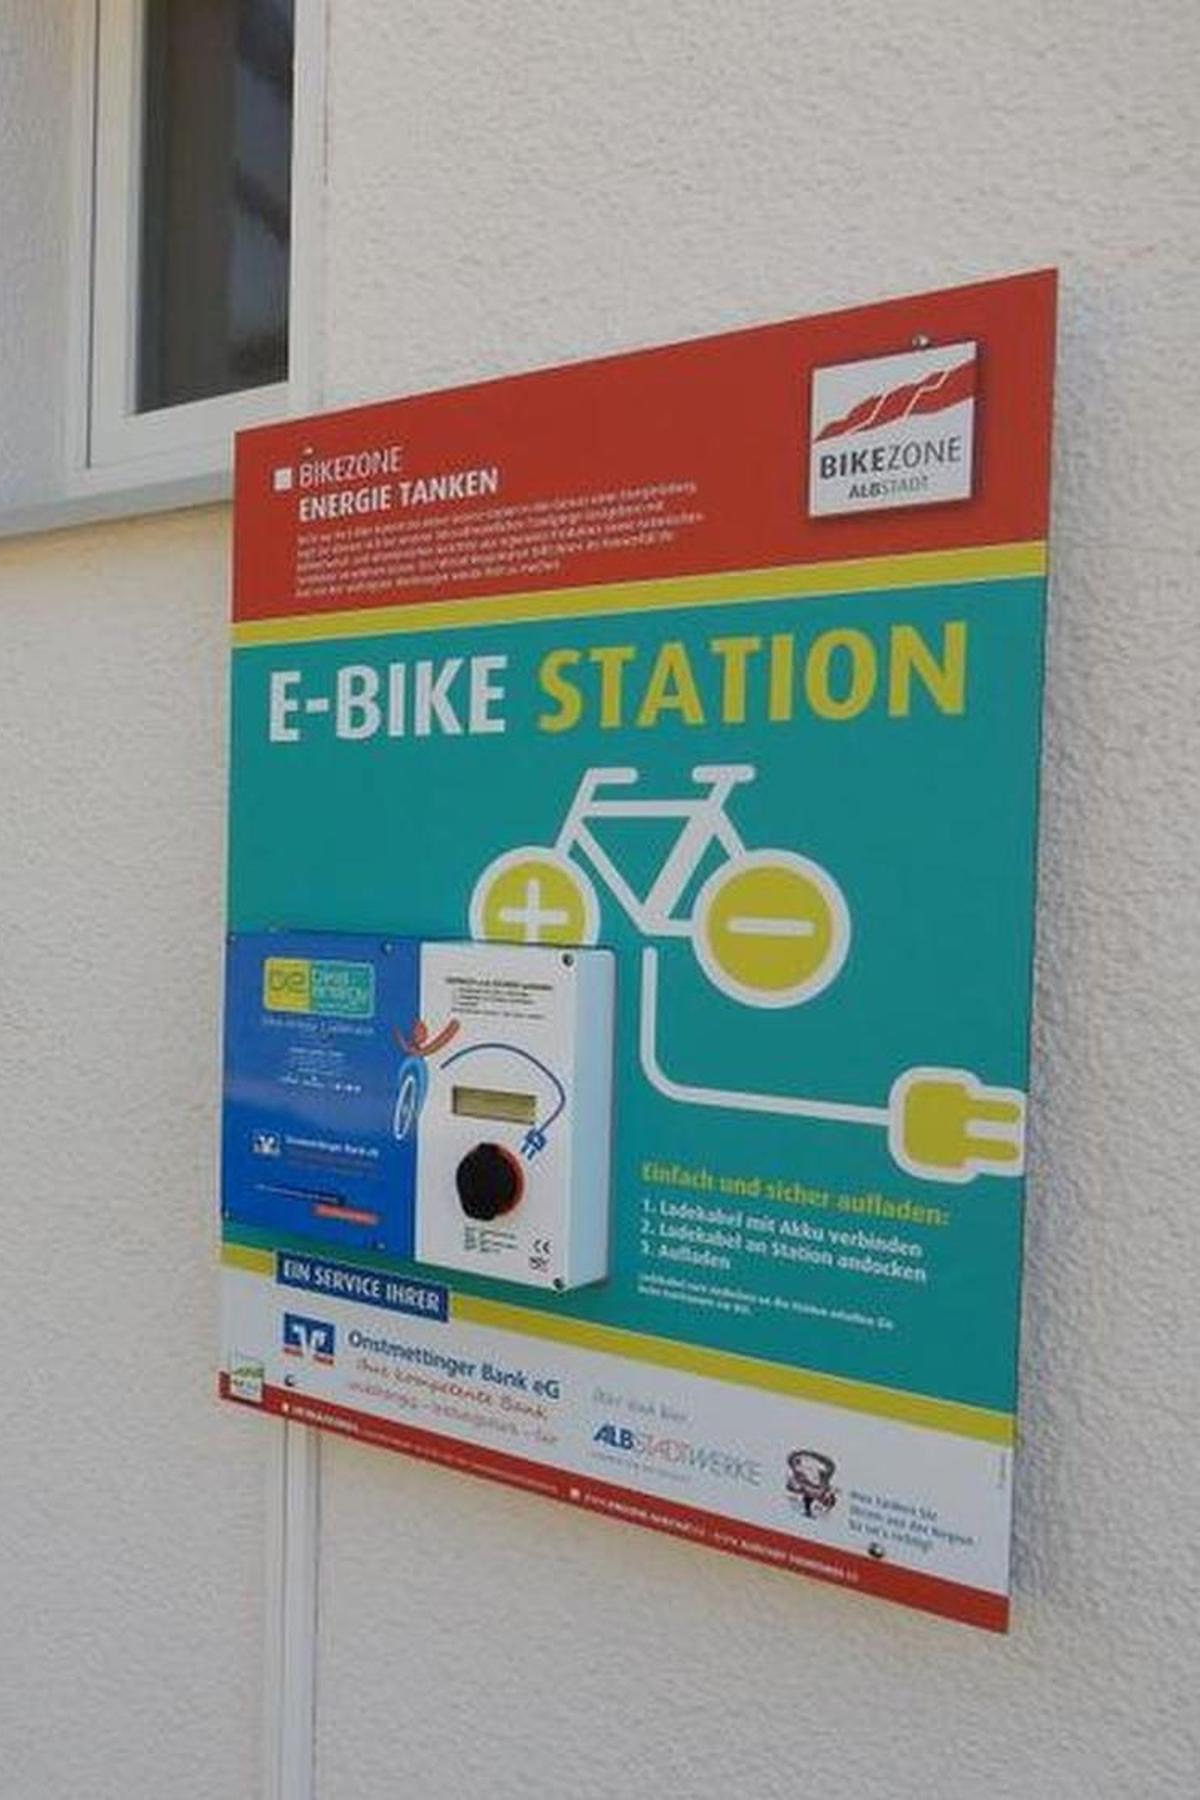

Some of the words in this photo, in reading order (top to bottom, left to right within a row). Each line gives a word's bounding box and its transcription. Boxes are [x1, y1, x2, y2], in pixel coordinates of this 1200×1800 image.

[300, 446, 402, 488] BIKEZONE
[819, 435, 962, 480] BIKEZONE
[299, 484, 392, 522] ENERGIE
[400, 467, 500, 507] TANKEN
[268, 655, 507, 743] E-BIKE
[537, 620, 969, 735] STATION
[641, 1160, 714, 1192] Einfach
[719, 1177, 761, 1198] und
[766, 1180, 830, 1208] sicher
[640, 1218, 656, 1235] 2.
[659, 1222, 742, 1250] Ladekabel
[744, 1238, 769, 1254] an
[772, 1240, 834, 1267] Station
[836, 1254, 927, 1284] andocken
[642, 1199, 657, 1214] 1.
[660, 1200, 743, 1229] Ladekabel
[745, 1214, 776, 1234] mit
[779, 1219, 824, 1242] Akku
[827, 1229, 923, 1259] verbinden
[658, 1243, 732, 1270] Aufladen
[283, 1258, 310, 1283] EIN
[314, 1263, 382, 1300] SERVICE
[385, 1281, 441, 1313] IHRER
[347, 1328, 477, 1379] Onstmettinger
[480, 1362, 528, 1391] Bank
[531, 1378, 560, 1400] eG
